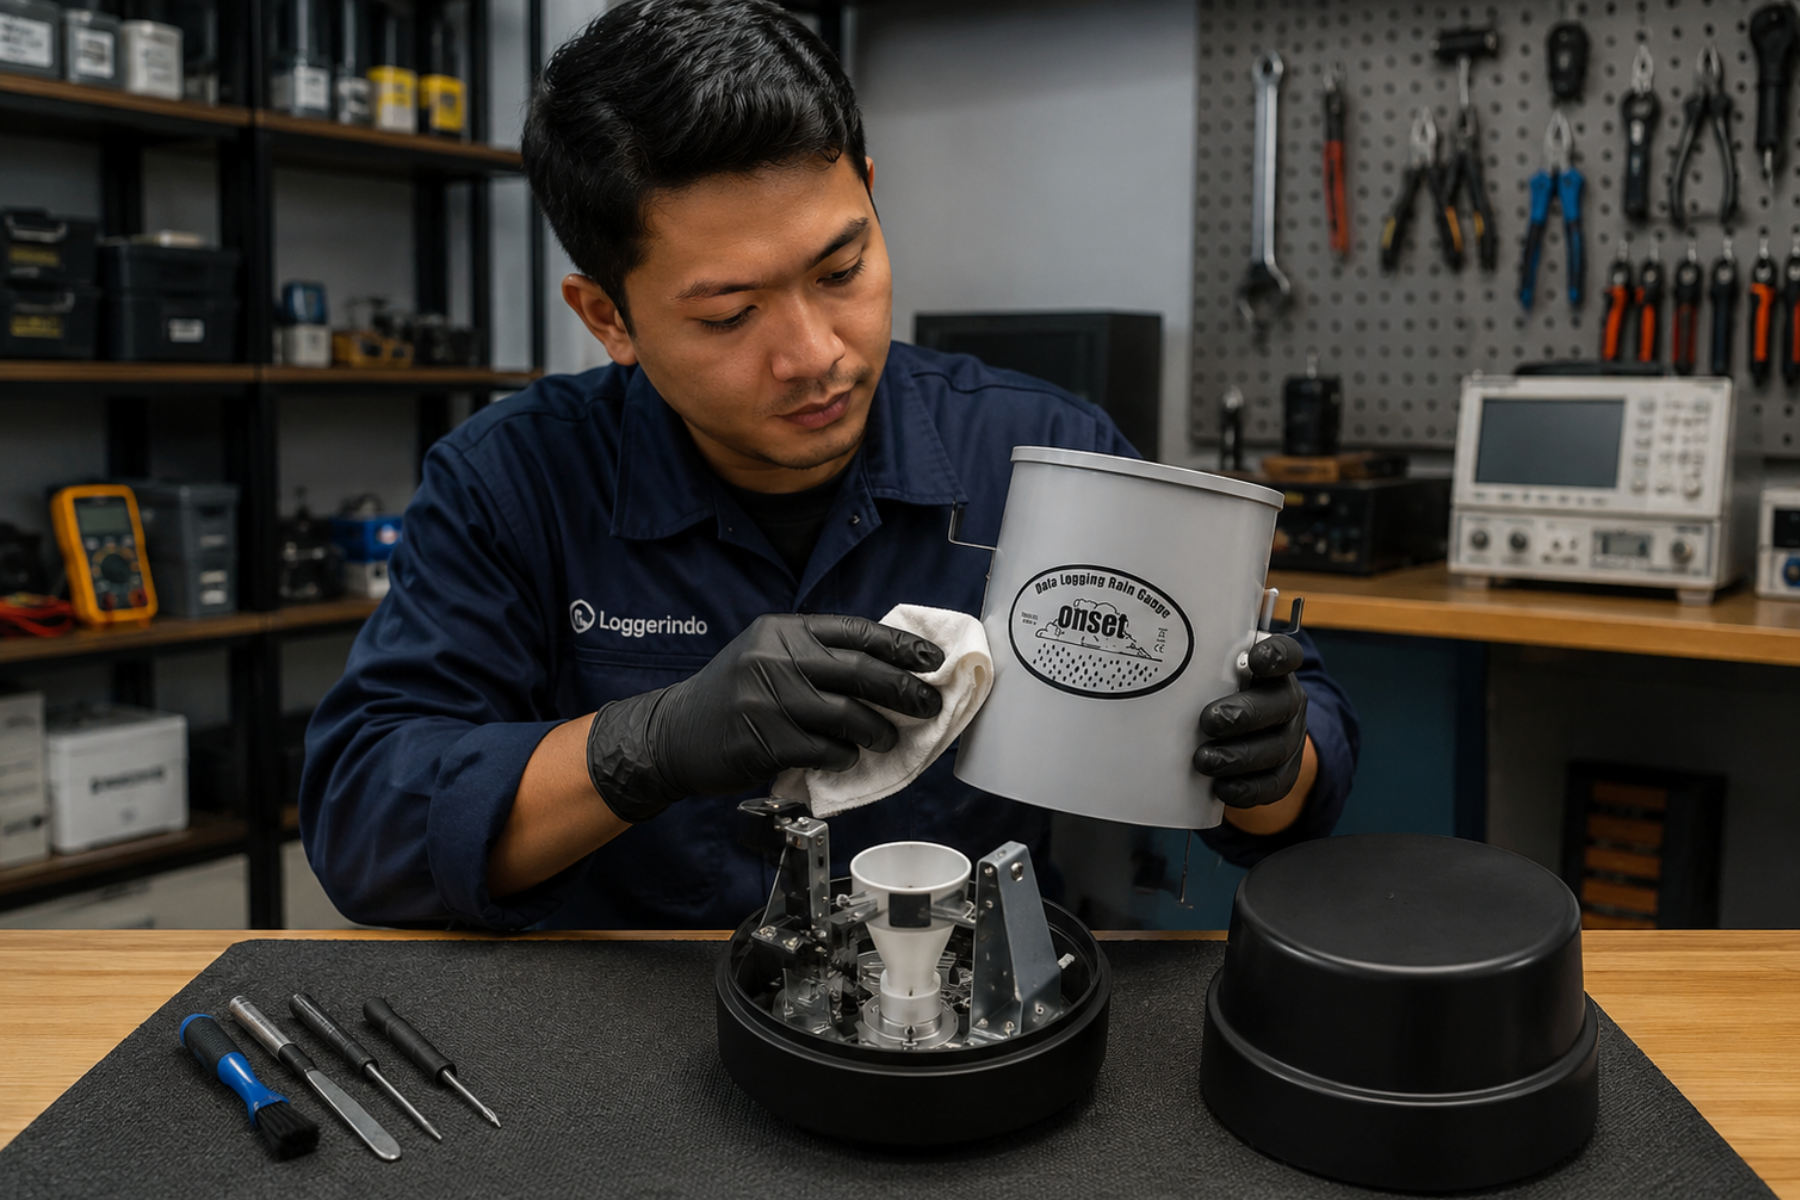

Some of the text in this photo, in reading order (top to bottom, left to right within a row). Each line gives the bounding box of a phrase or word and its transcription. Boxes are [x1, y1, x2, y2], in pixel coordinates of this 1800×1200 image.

[1035, 573, 1171, 619] Data Logging Rain Gauge
[600, 610, 707, 638] Loggerindo
[1058, 605, 1127, 639] onset
